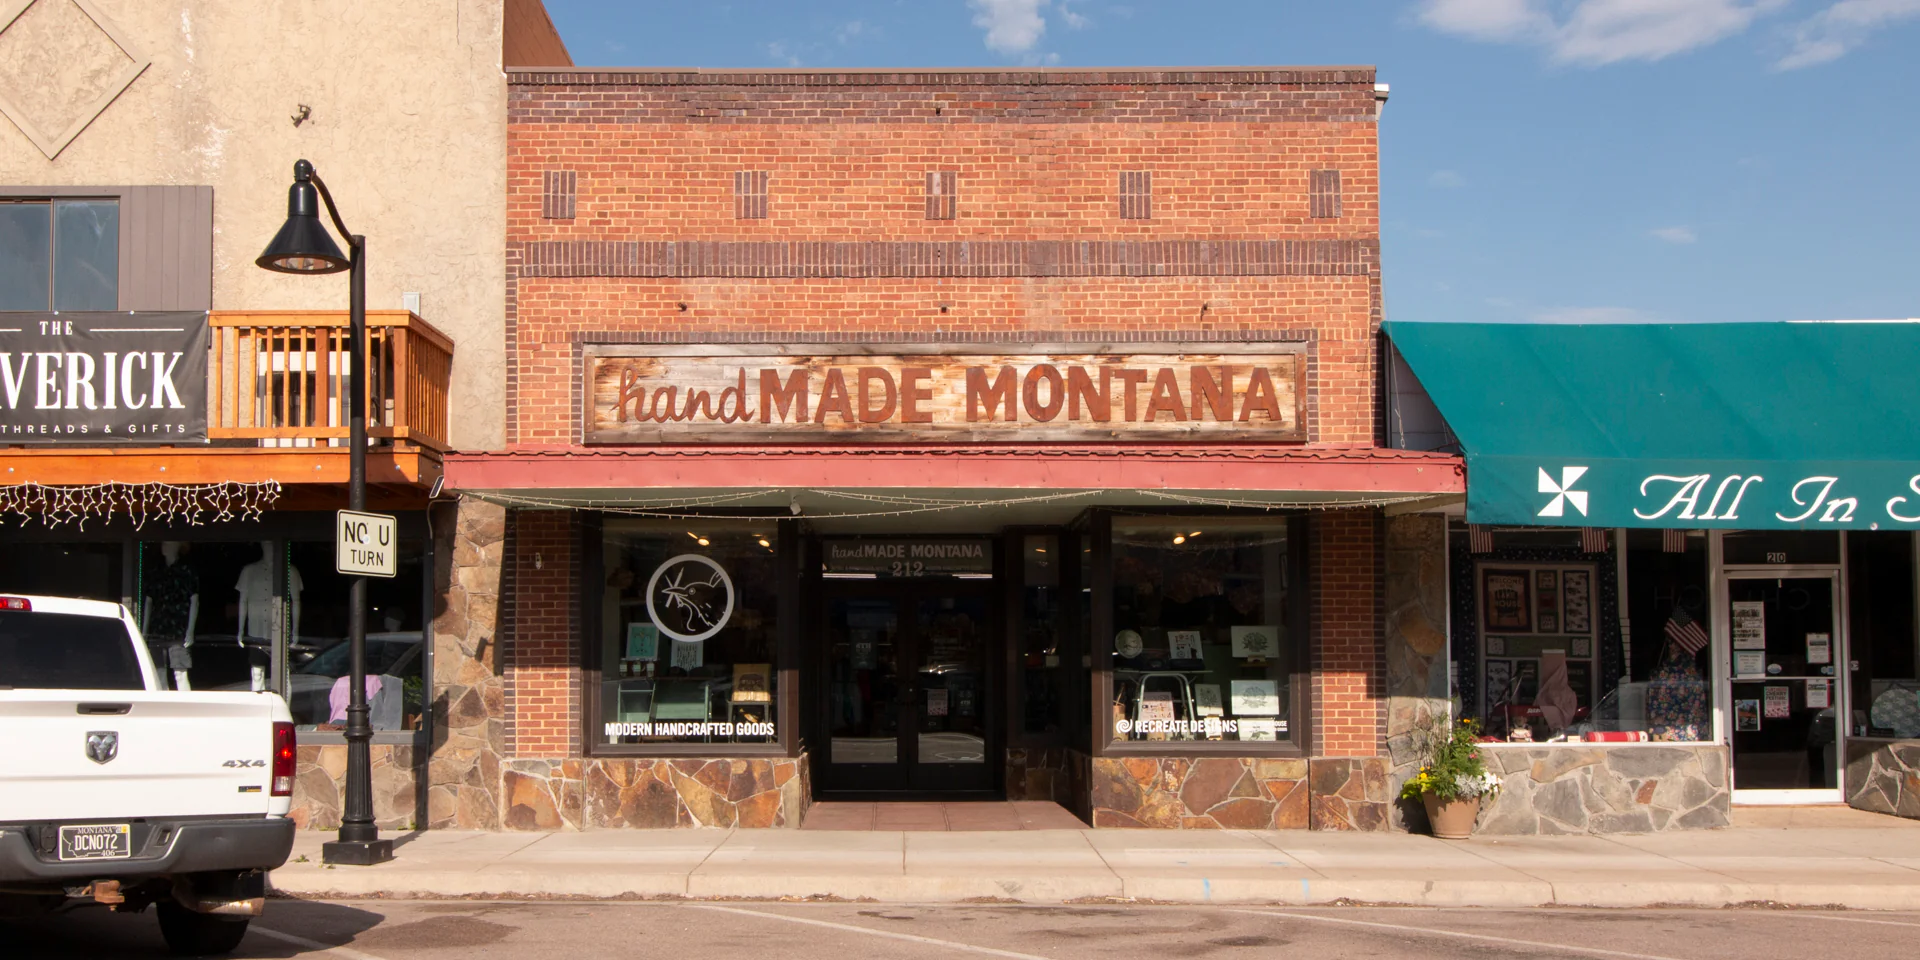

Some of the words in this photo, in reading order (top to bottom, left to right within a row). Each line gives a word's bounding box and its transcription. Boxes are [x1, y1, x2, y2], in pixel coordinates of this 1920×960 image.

[39, 320, 73, 336] THE
[0, 351, 186, 410] VERICK
[964, 362, 1284, 423] MONTANA
[0, 424, 89, 434] THREADS
[104, 424, 112, 434] &
[128, 423, 186, 434] GIFTS
[1633, 473, 1763, 520] All
[1775, 475, 1858, 523] In
[344, 520, 369, 545] NO
[378, 524, 390, 547] U
[350, 549, 384, 567] TURN
[910, 544, 984, 559] MONTANA
[1767, 553, 1785, 562] 210
[891, 560, 925, 577] 212
[604, 722, 653, 736] MODERN
[654, 722, 733, 736] HANDCRAFTED
[735, 722, 775, 736] GOODS
[1134, 719, 1189, 733] RECREATE
[1190, 719, 1238, 733] DESIGNS
[77, 825, 113, 835] MONTANA
[74, 833, 118, 851] DCN072
[100, 849, 116, 857] 406
